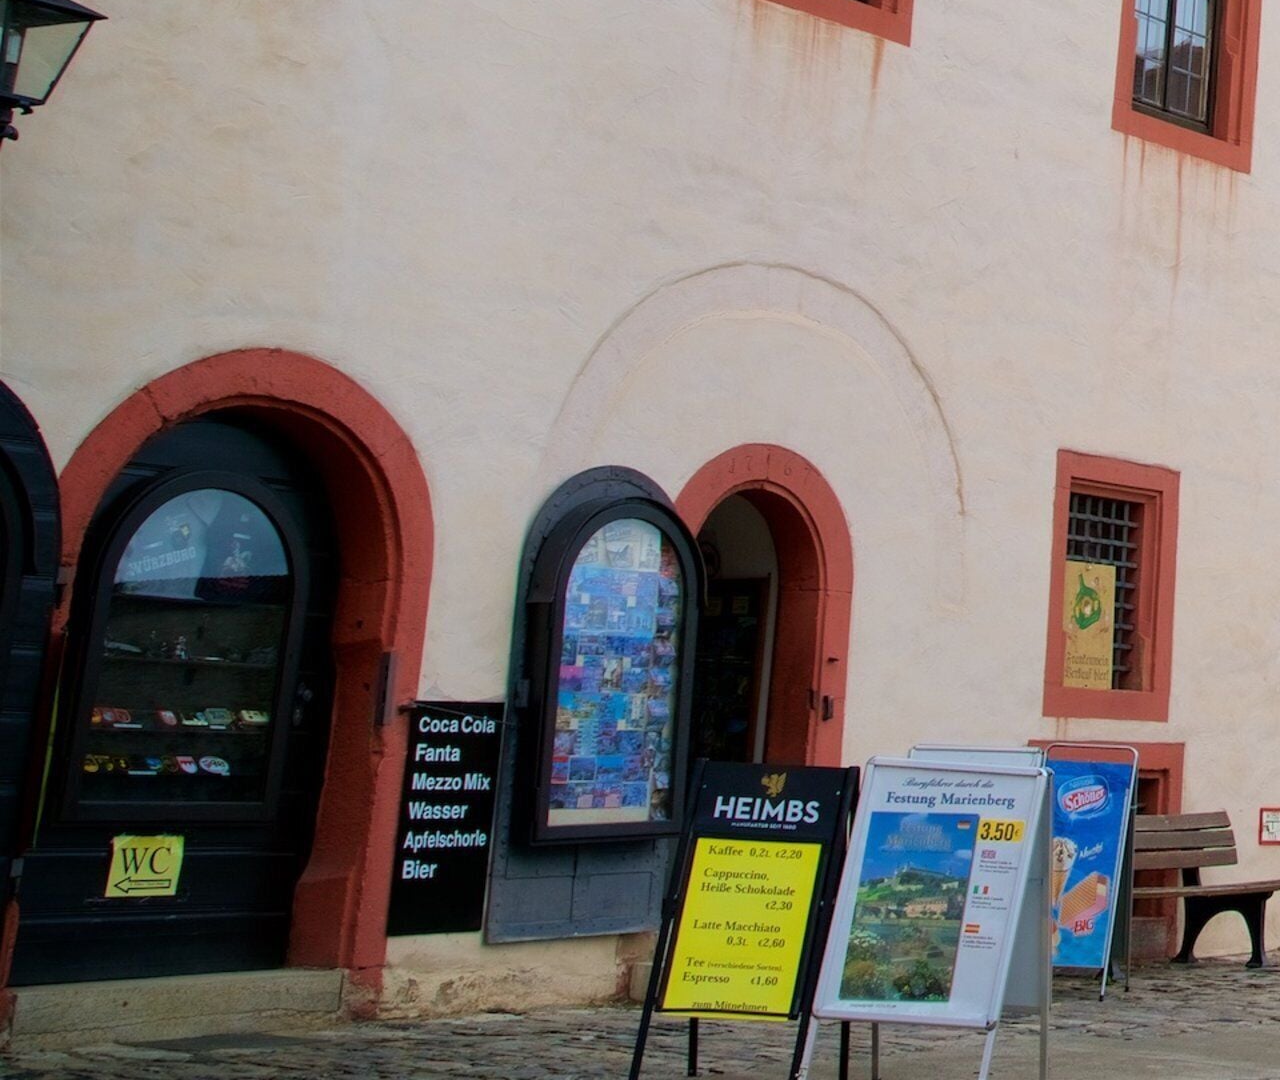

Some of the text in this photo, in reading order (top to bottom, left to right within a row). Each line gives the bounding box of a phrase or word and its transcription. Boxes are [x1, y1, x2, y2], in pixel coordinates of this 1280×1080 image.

[419, 715, 496, 733] Coca Cola
[415, 743, 461, 762] Fanta
[412, 772, 491, 790] Mezzo Mix
[954, 779, 981, 789] durch
[981, 780, 995, 789] die
[886, 791, 1016, 808] Festung Marienberg
[408, 801, 469, 819] Wasser
[713, 796, 820, 824] HEIMBS
[403, 829, 487, 853] Apfelschorle
[708, 845, 744, 856] Kaffee
[121, 846, 171, 875] WC
[402, 860, 438, 879] Bier
[704, 867, 770, 881] Cappuccino,
[701, 882, 796, 896] Heiße Schokolade
[693, 919, 781, 933] Latte Macchiato
[686, 957, 706, 967] Tee
[682, 971, 730, 985] Espresso
[691, 1000, 769, 1012] zum Mitnehmen
